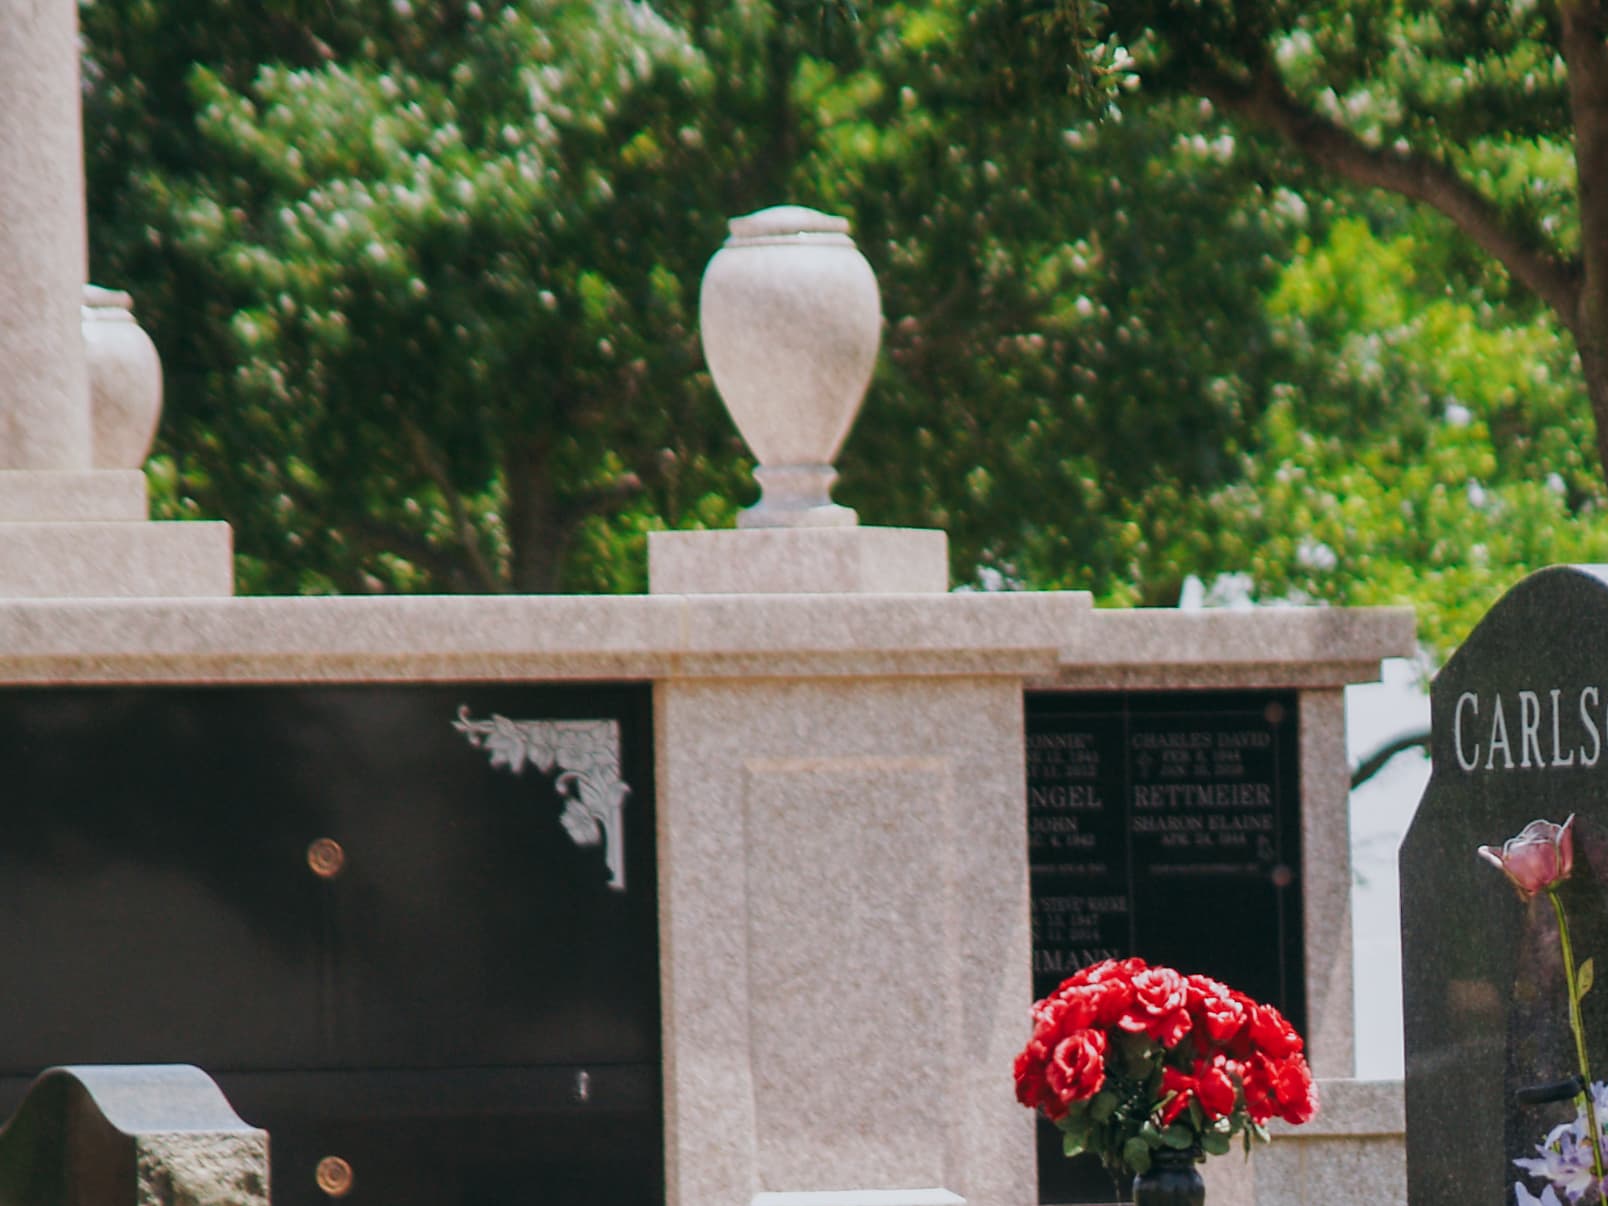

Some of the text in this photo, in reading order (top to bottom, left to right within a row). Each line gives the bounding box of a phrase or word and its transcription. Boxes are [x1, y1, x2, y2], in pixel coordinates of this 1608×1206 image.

[1217, 731, 1271, 748] DAVID
[1134, 784, 1271, 807] RETTMEIER
[1208, 815, 1273, 831] ELAINE
